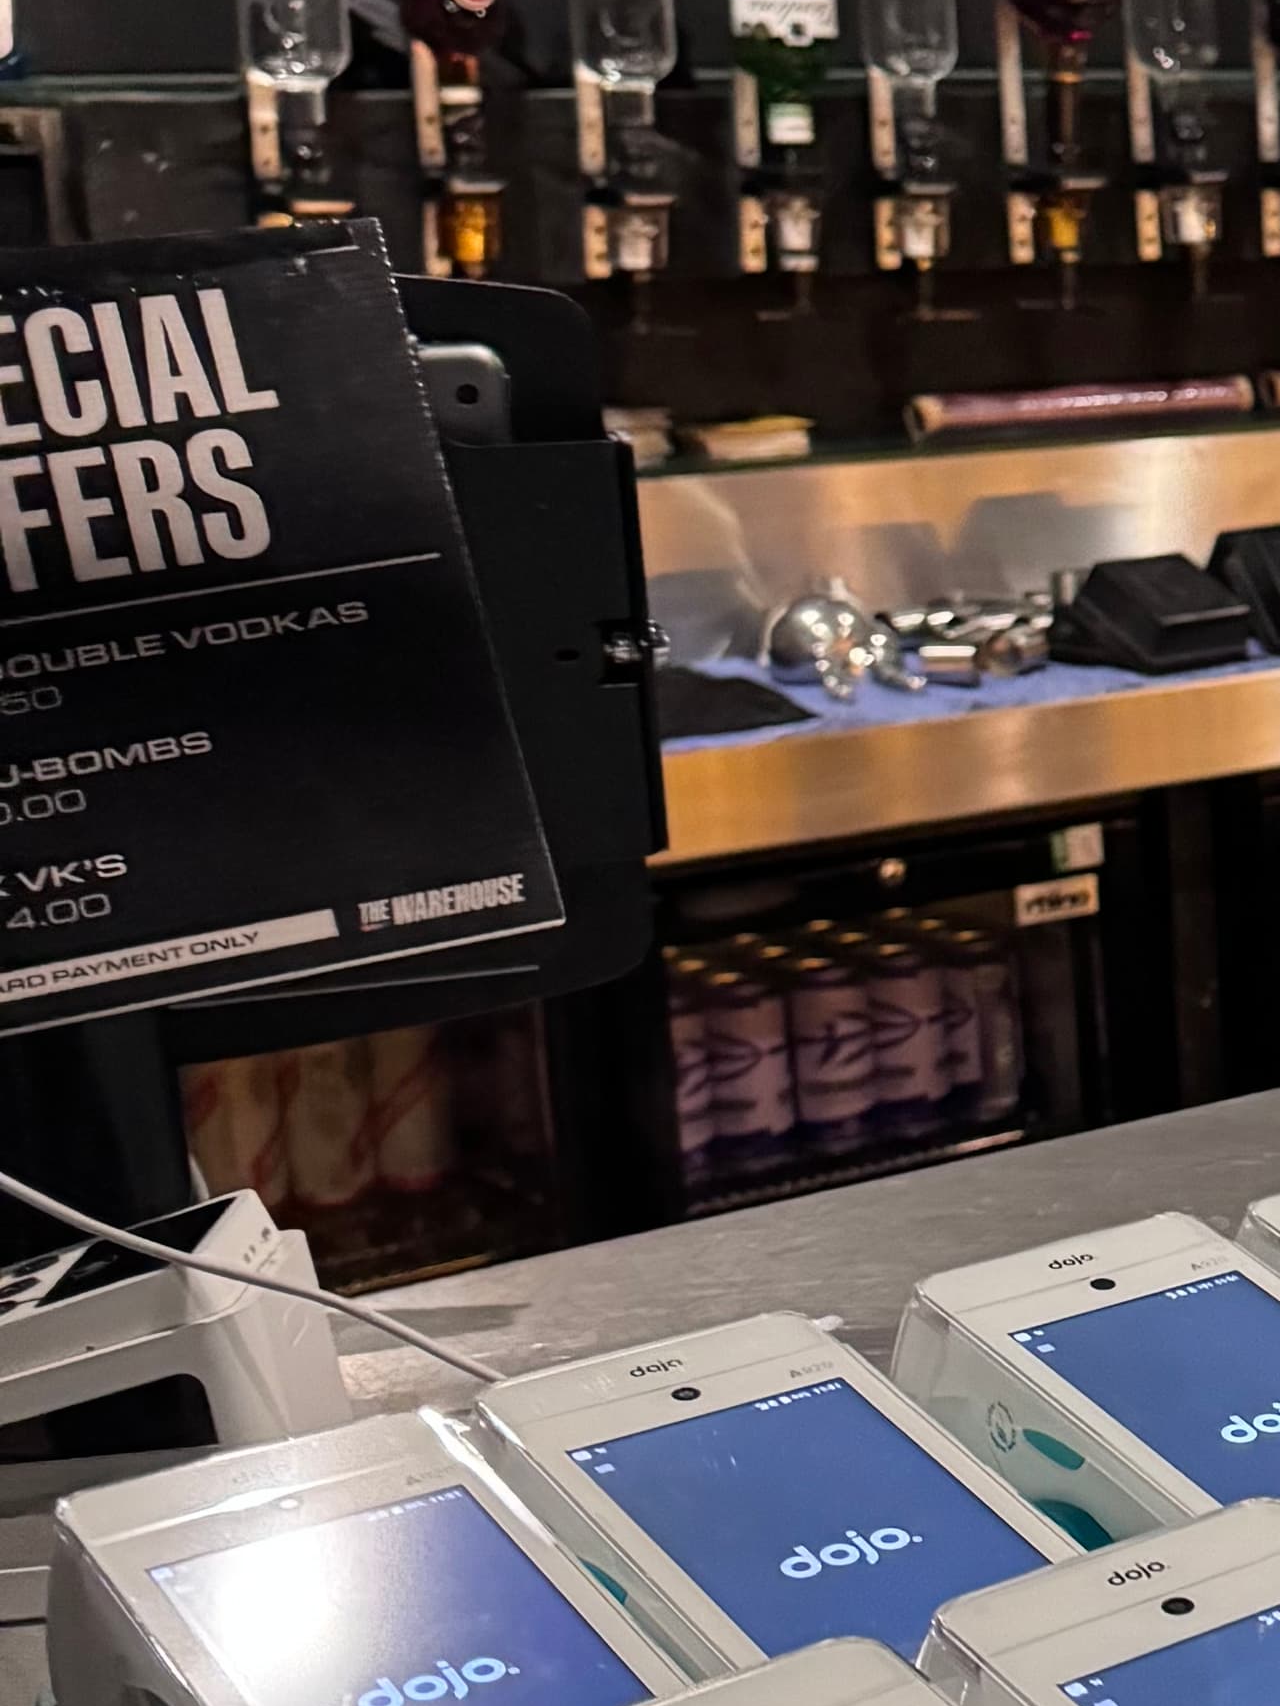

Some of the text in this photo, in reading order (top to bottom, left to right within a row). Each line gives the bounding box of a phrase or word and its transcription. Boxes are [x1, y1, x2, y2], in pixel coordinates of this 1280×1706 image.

[0, 601, 369, 680] OUBLE VODKAS
[16, 853, 128, 892] VK'S
[358, 872, 527, 926] THE WAREHOUSE
[51, 946, 185, 984] PAYMENT
[189, 930, 259, 958] ONLY
[779, 1526, 924, 1580] dojo.
